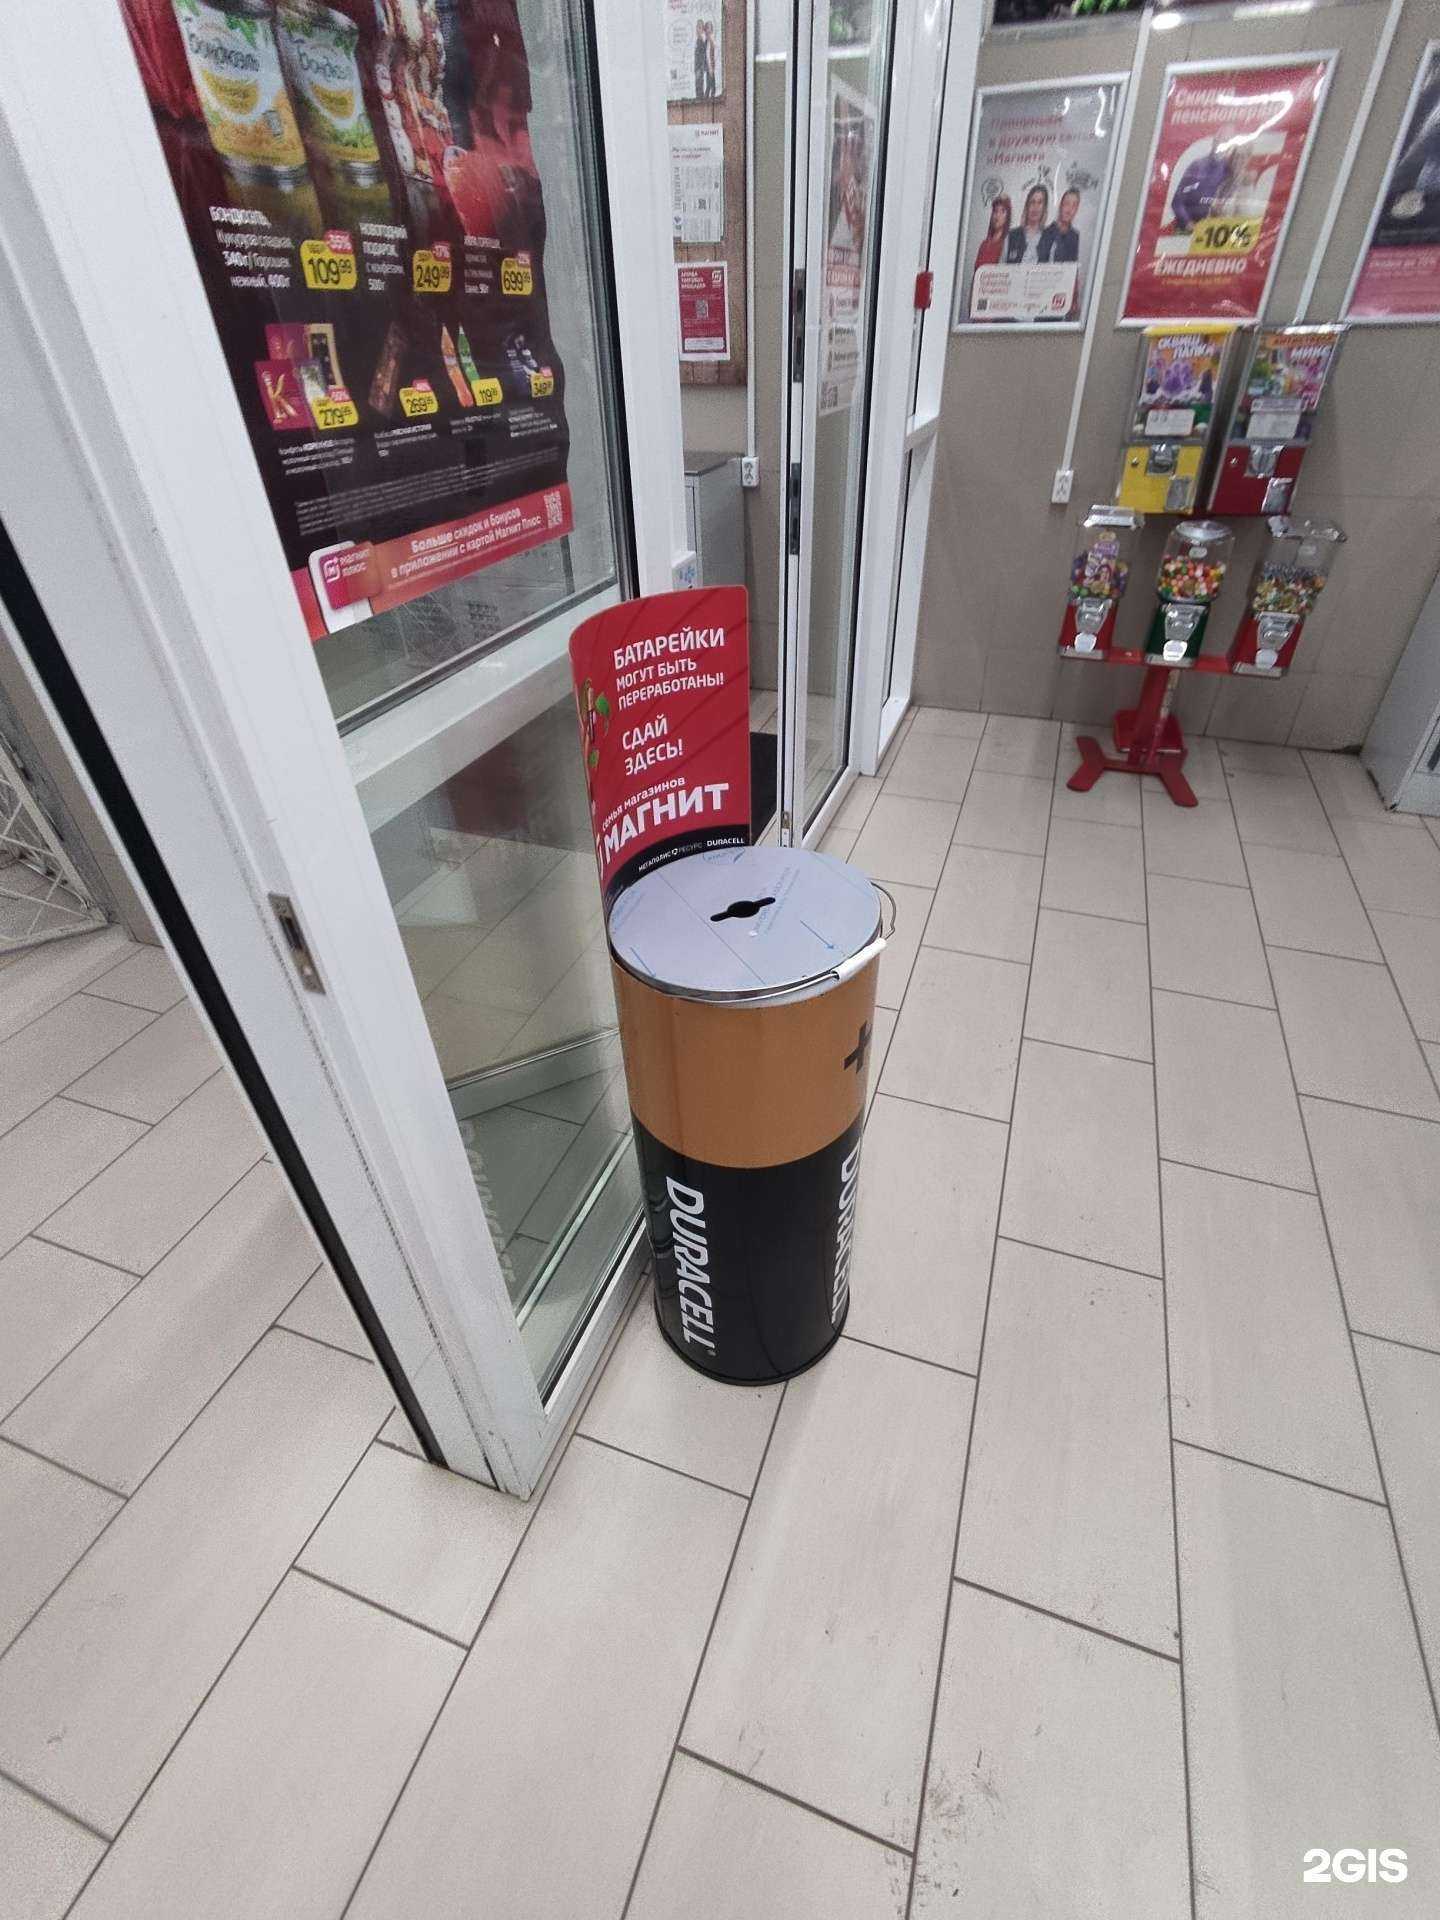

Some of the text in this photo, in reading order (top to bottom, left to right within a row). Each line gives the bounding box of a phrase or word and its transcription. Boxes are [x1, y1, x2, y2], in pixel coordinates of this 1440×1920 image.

[1193, 222, 1251, 249] -10%
[410, 530, 453, 553] Больше
[613, 626, 725, 672] БАТАРЕЙКИ
[615, 657, 697, 694] МОГУТ БЫТЬ
[617, 671, 725, 712] ПЕРЕРАБОТАНЫ!
[621, 714, 669, 753] СДАЙ
[624, 738, 684, 777] ЗДЕСЬ!
[623, 777, 686, 811] магазинов
[603, 783, 730, 865] МАГНИТ
[705, 837, 746, 849] DURACELL
[638, 850, 672, 873] МЕГАПОЛИС
[665, 1175, 715, 1350] DURACELL
